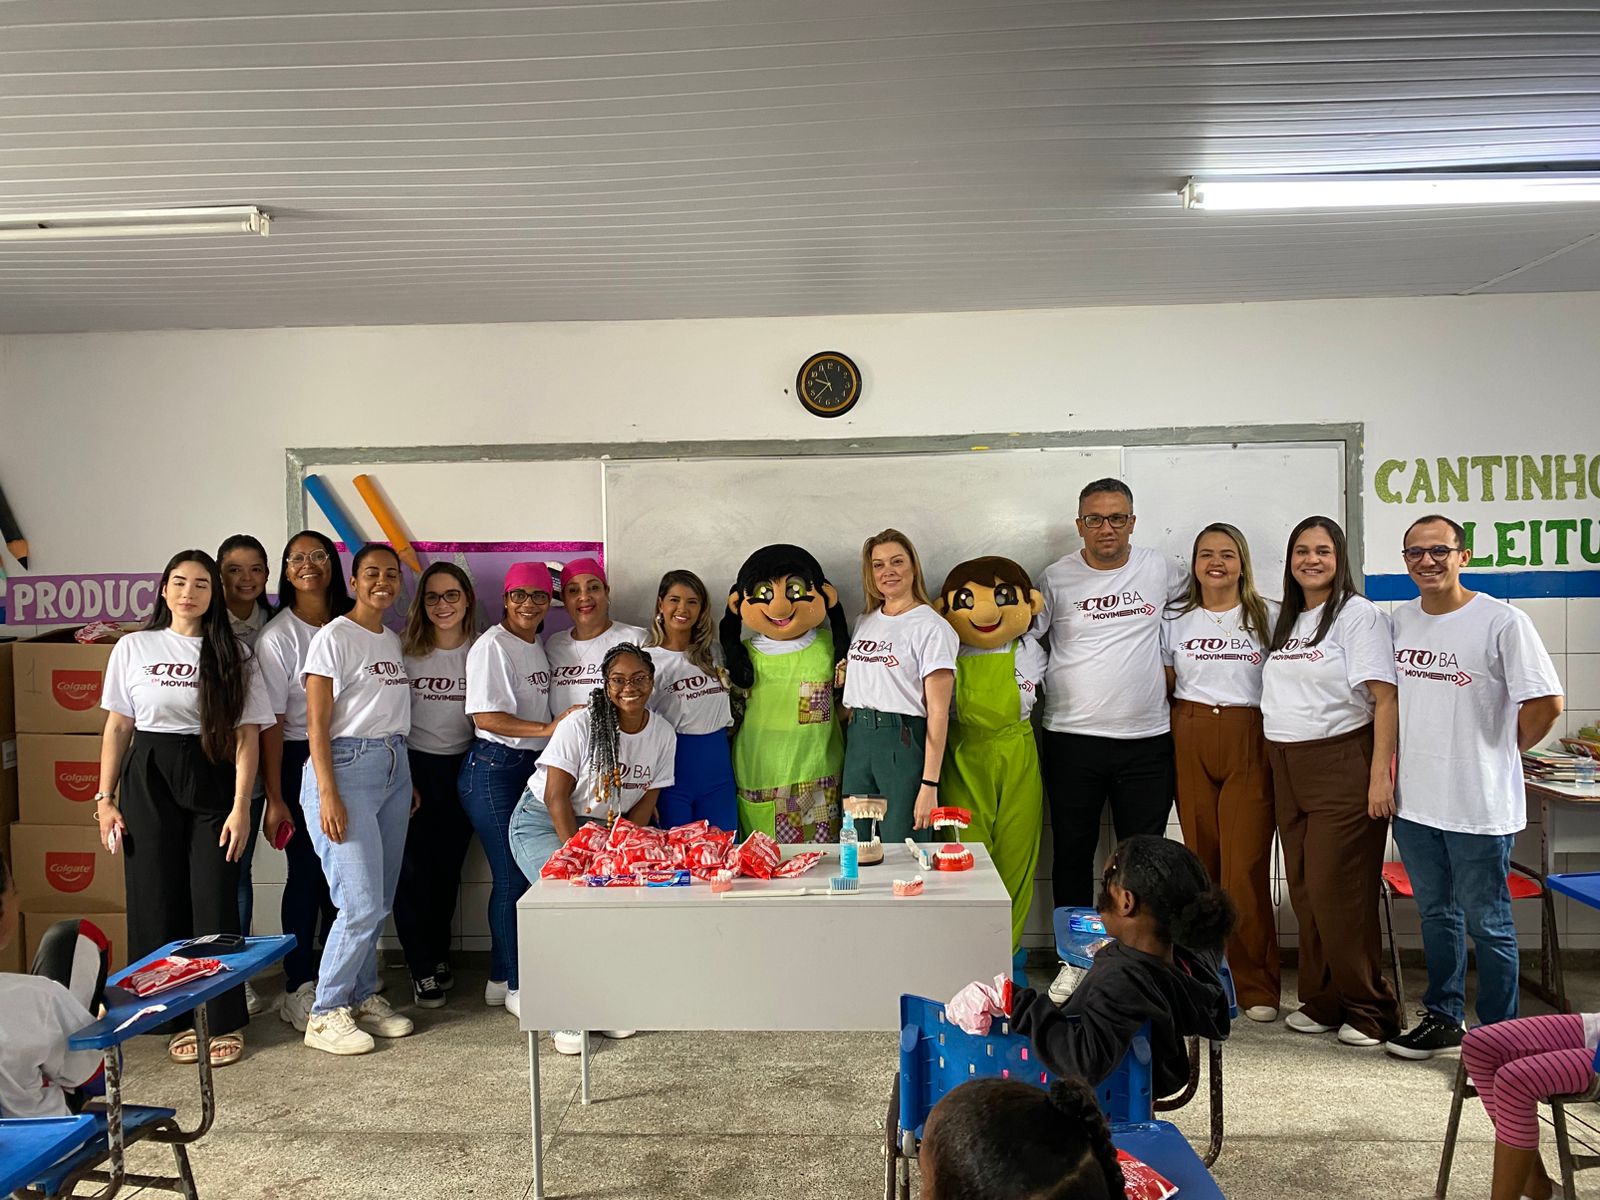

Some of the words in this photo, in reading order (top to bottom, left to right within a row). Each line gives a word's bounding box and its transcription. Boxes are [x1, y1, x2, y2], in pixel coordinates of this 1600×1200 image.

[13, 580, 159, 621] PRODUÇ
[1122, 590, 1144, 605] BA
[1092, 607, 1147, 620] MOVIMENTO
[1231, 638, 1253, 650] BA
[1195, 653, 1254, 662] MOVIMENTO
[1439, 652, 1459, 669] BA
[1405, 669, 1459, 682] MOVIMENTO
[57, 681, 98, 692] Colgate
[633, 764, 651, 779] BA
[60, 773, 98, 784] Colgate
[50, 864, 91, 875] Colgate
